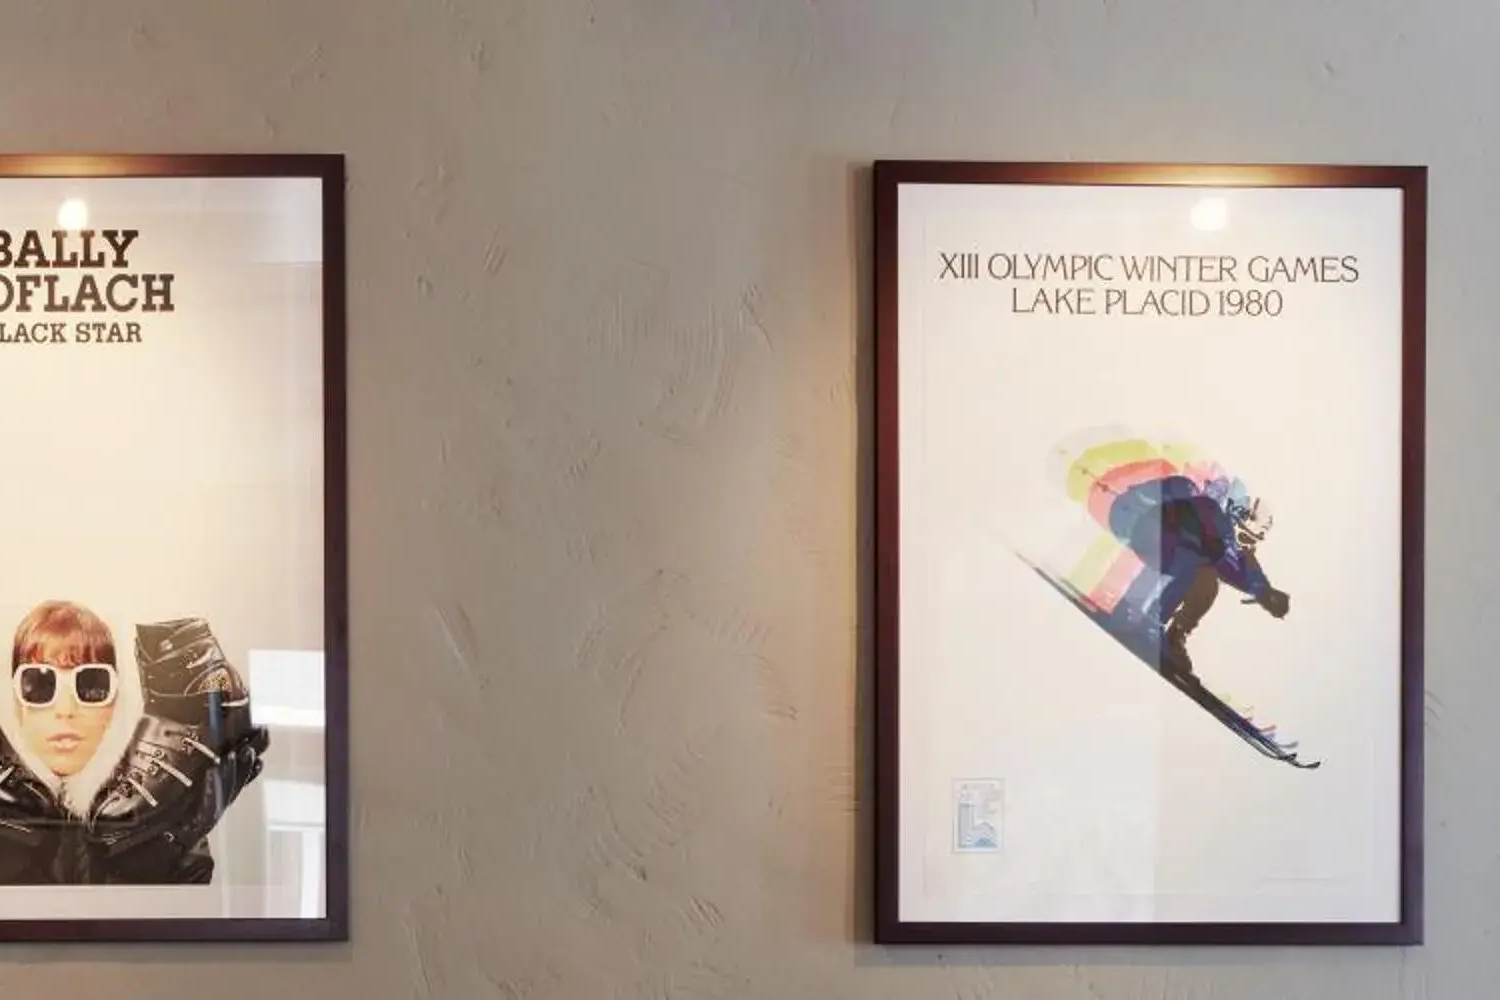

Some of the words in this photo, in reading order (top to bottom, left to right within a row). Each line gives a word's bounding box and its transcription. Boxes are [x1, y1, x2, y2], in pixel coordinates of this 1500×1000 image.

[938, 252, 979, 280] XIII
[987, 253, 1114, 281] OLYMPIC
[1119, 255, 1237, 283] WINTER
[1247, 255, 1360, 283] GAMES
[1011, 288, 1096, 315] LAKE
[1104, 288, 1211, 317] PLACID
[1218, 289, 1284, 318] 1980
[75, 322, 143, 343] STAR
